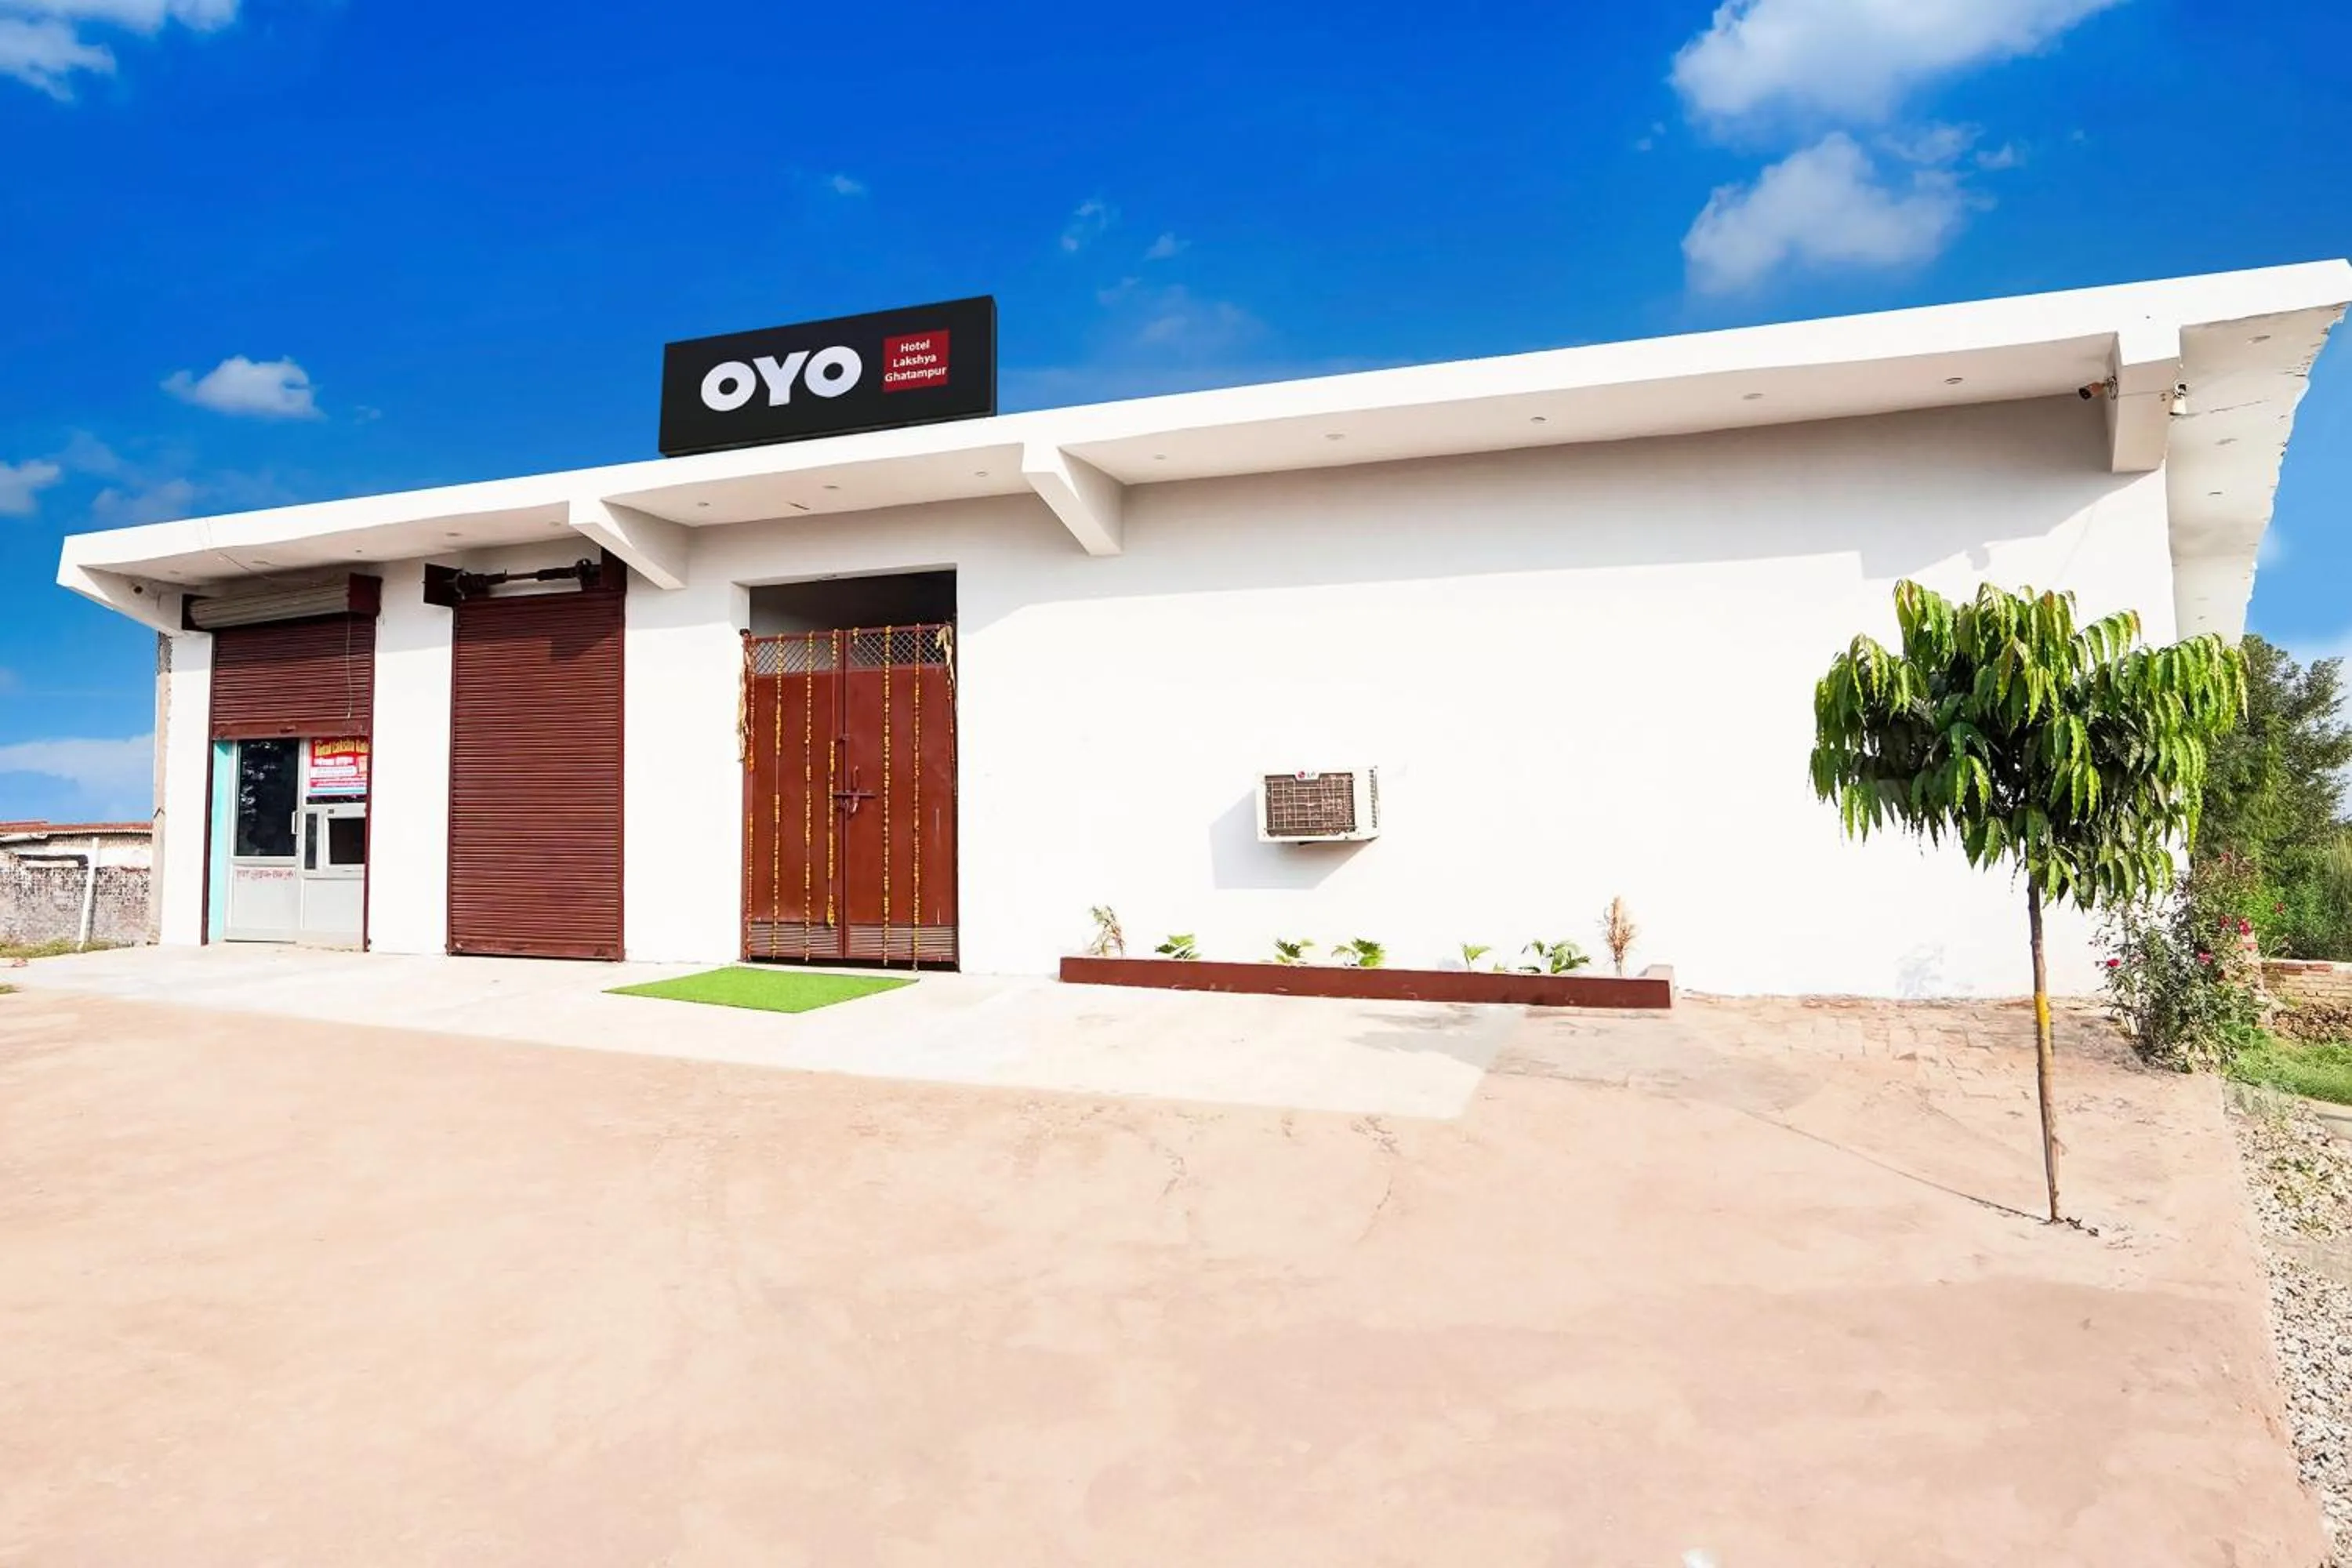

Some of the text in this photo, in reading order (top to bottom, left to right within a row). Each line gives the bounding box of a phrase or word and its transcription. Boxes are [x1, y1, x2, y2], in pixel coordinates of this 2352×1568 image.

[900, 339, 930, 353] Hotel
[892, 354, 937, 368] Lakshya
[700, 345, 862, 412] OYO
[884, 366, 947, 382] Ghatampur
